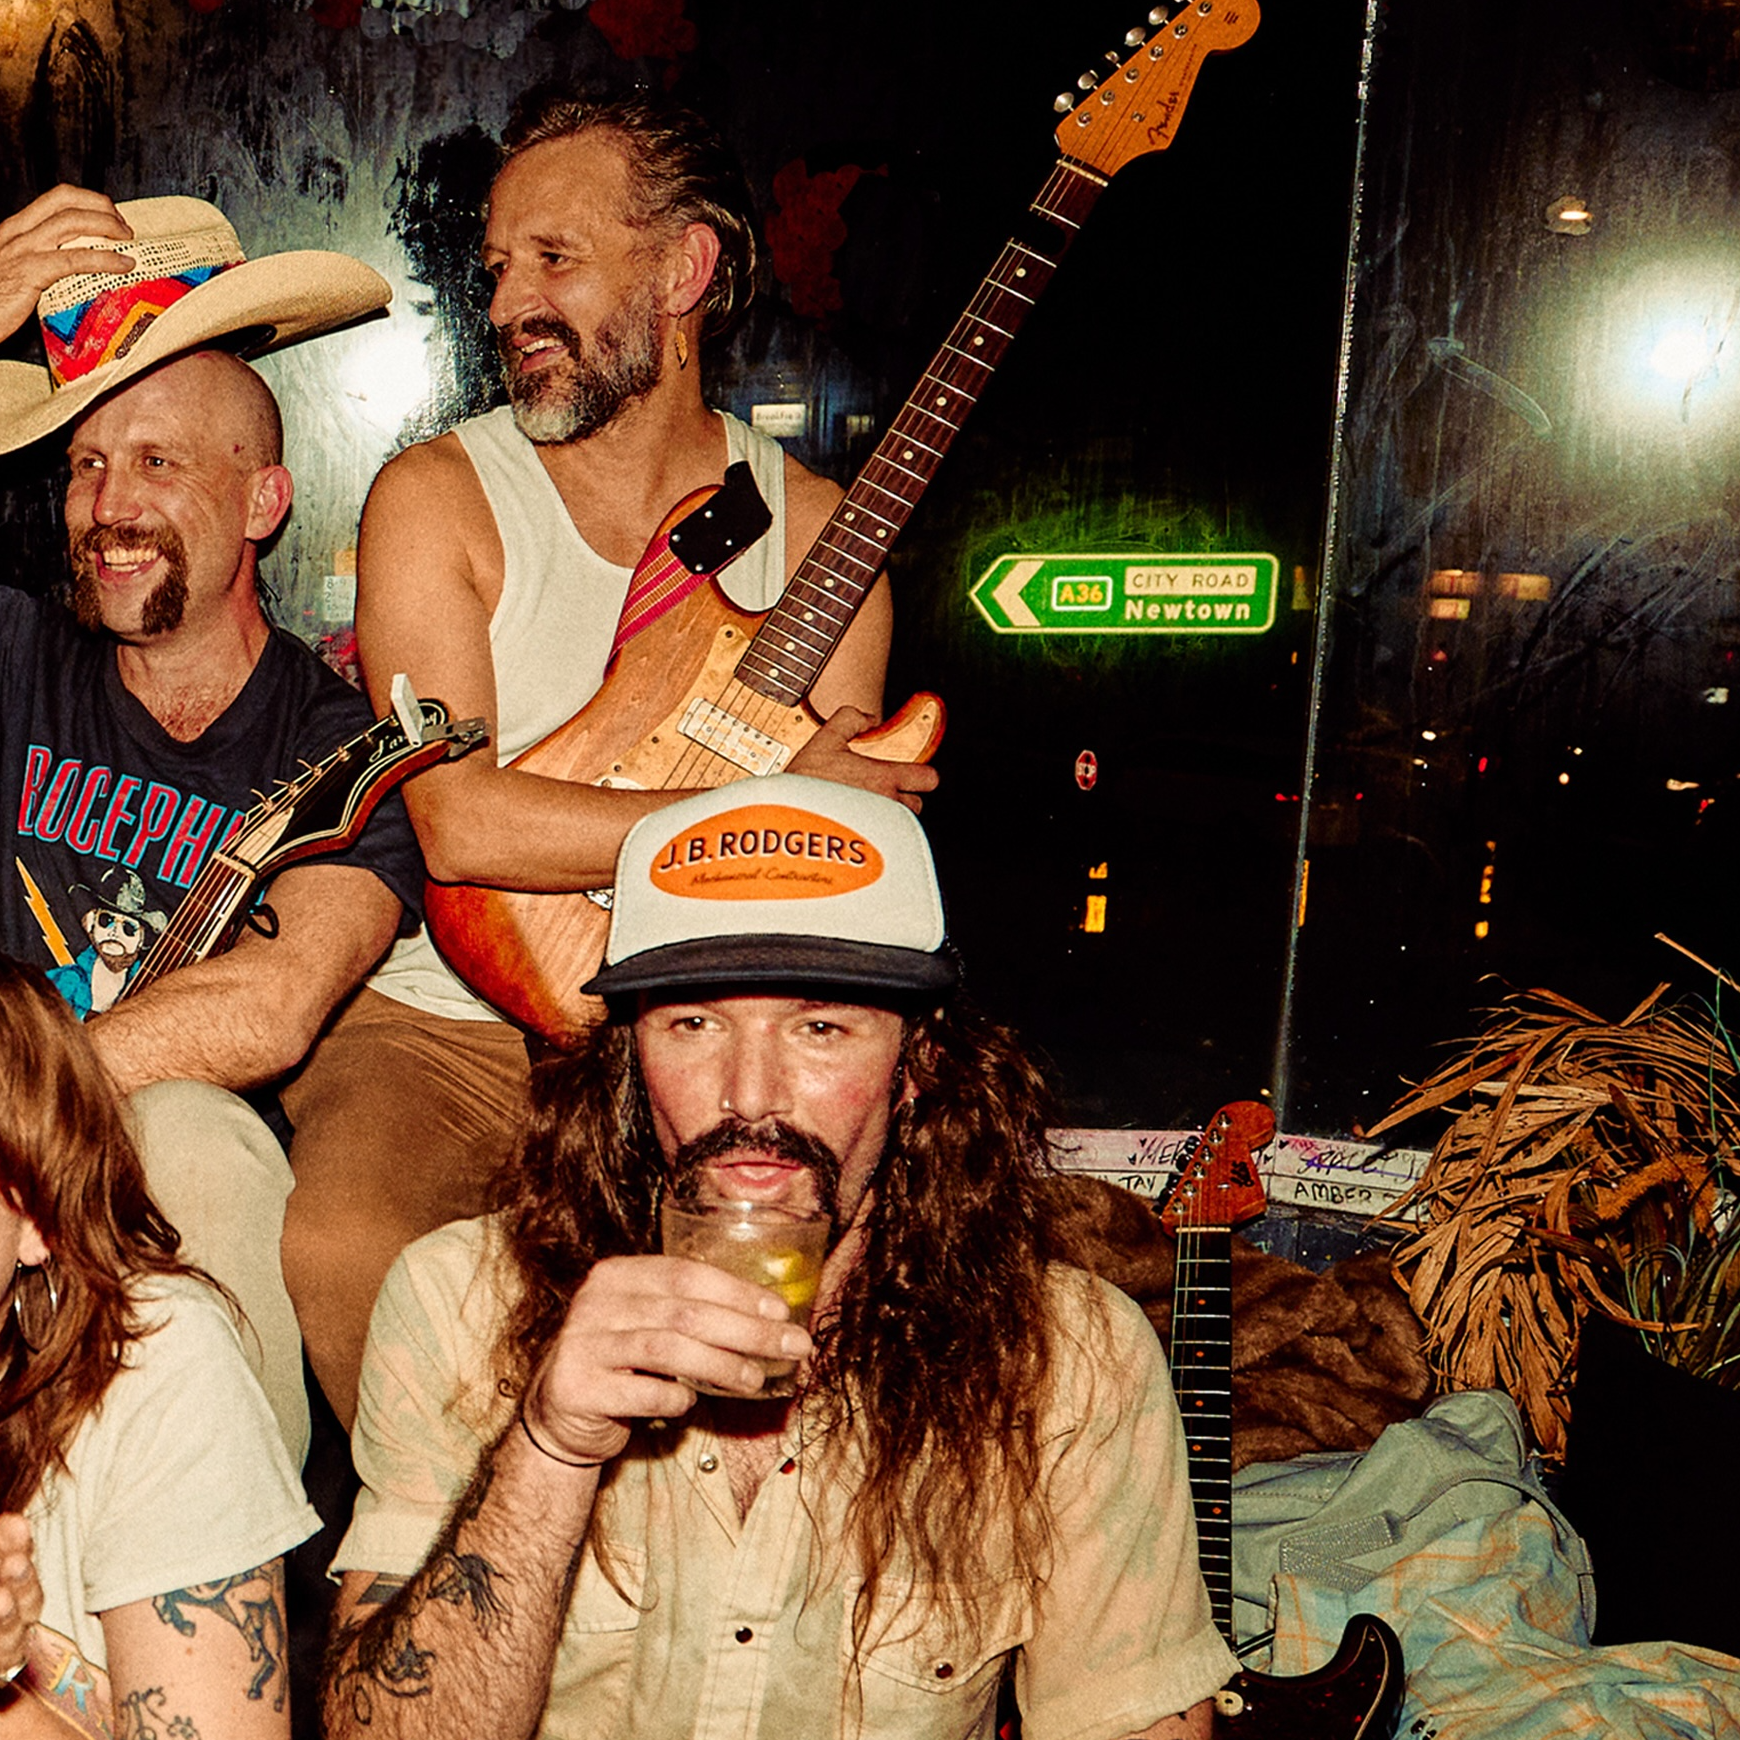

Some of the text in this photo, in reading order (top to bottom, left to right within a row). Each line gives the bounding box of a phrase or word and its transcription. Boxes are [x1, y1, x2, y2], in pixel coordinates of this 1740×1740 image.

[1147, 92, 1180, 146] Fender
[1132, 573, 1250, 588] CITY ROAD
[1060, 583, 1104, 604] A36
[1124, 599, 1251, 621] Newtown
[720, 829, 867, 866] RODGERS
